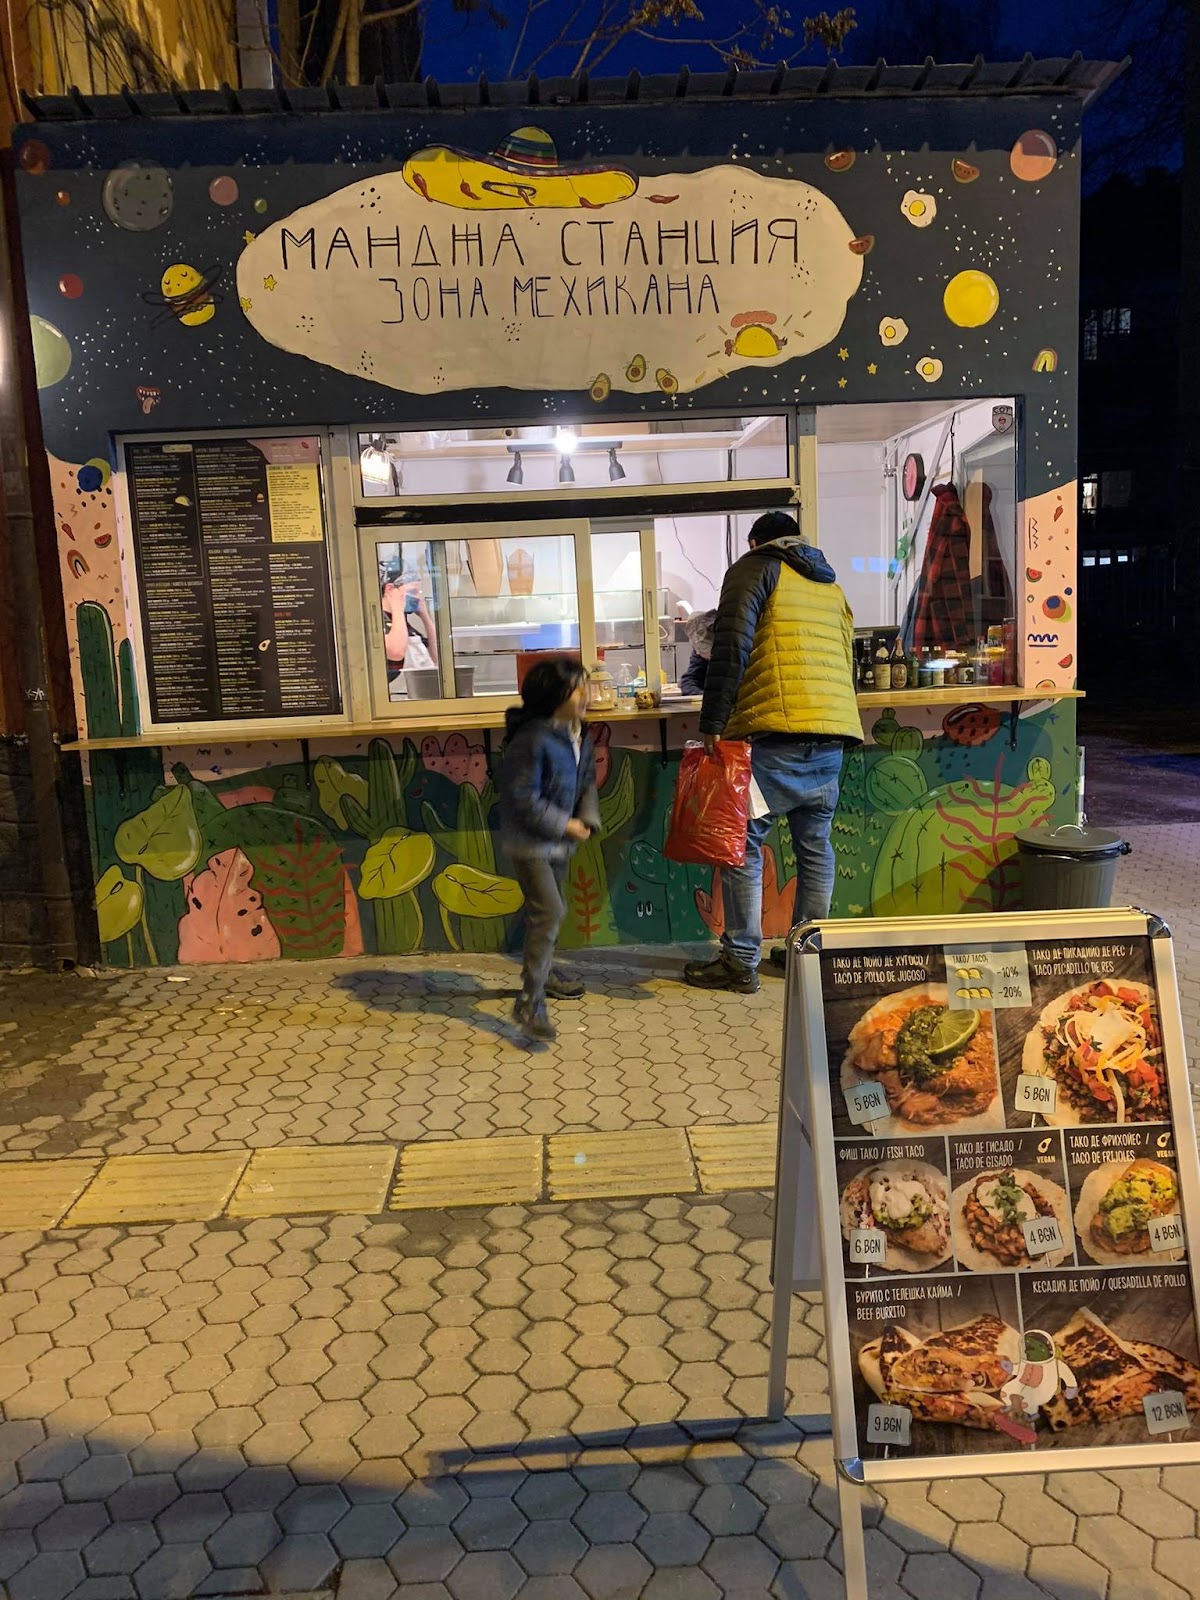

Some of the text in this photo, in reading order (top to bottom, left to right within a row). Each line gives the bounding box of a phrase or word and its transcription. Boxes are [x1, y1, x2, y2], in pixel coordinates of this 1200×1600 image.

[281, 218, 798, 270] МАНДЖА СТАНЦИЯ
[378, 273, 720, 324] ЗОНА МЕХИКАНА
[1032, 949, 1051, 960] ТАКО
[1053, 948, 1062, 959] ДЕ
[1102, 946, 1111, 957] ДЕ
[1112, 945, 1126, 956] РЕС
[832, 956, 851, 968] ТАКО
[853, 956, 861, 968] ДЕ
[863, 955, 882, 968] ПОЙО
[884, 956, 893, 967] ДЕ
[895, 954, 923, 966] ХУГОСО
[1033, 961, 1115, 975] TACO PICADILLO DE RES
[833, 969, 926, 984] TACO DE POLLO DE JUGOSO
[997, 966, 1019, 978] -10%
[998, 986, 1022, 998] -20%
[1024, 1085, 1050, 1102] 5 BGN
[854, 1092, 881, 1112] 5 BGN
[954, 1142, 974, 1154] ТАКО
[975, 1141, 984, 1154] ДЕ
[985, 1140, 1014, 1153] ГИСАДО
[1069, 1135, 1089, 1148] ТАКО
[1090, 1135, 1100, 1147] ДЕ
[839, 1148, 858, 1160] ФИШ
[860, 1147, 879, 1160] ТАКО
[887, 1146, 904, 1158] FISH
[905, 1144, 925, 1157] TACO
[1036, 1155, 1056, 1164] VEGAN
[1070, 1150, 1136, 1164] TACO DE FRIJOLES
[955, 1154, 1013, 1170] TACO DE GISADO
[1030, 1226, 1057, 1245] 4 BGN
[1154, 1224, 1181, 1242] 4 BGN
[855, 1239, 881, 1254] 6 BGN
[1032, 1279, 1067, 1293] КЕСАДИЯ
[1068, 1278, 1078, 1292] ДЕ
[1079, 1277, 1100, 1291] ПОЙО
[1107, 1275, 1151, 1291] QUESADILLA
[1152, 1274, 1162, 1288] DE
[1163, 1273, 1187, 1287] POLLO
[855, 1289, 884, 1303] БУРИТО
[884, 1288, 890, 1301] С
[891, 1287, 926, 1301] ТЕЛЕШКА
[926, 1284, 953, 1299] КАЙМА
[856, 1305, 906, 1320] BEEF BURRITO
[1152, 1402, 1184, 1421] 12 BGN
[874, 1416, 902, 1433] 9 BGN
